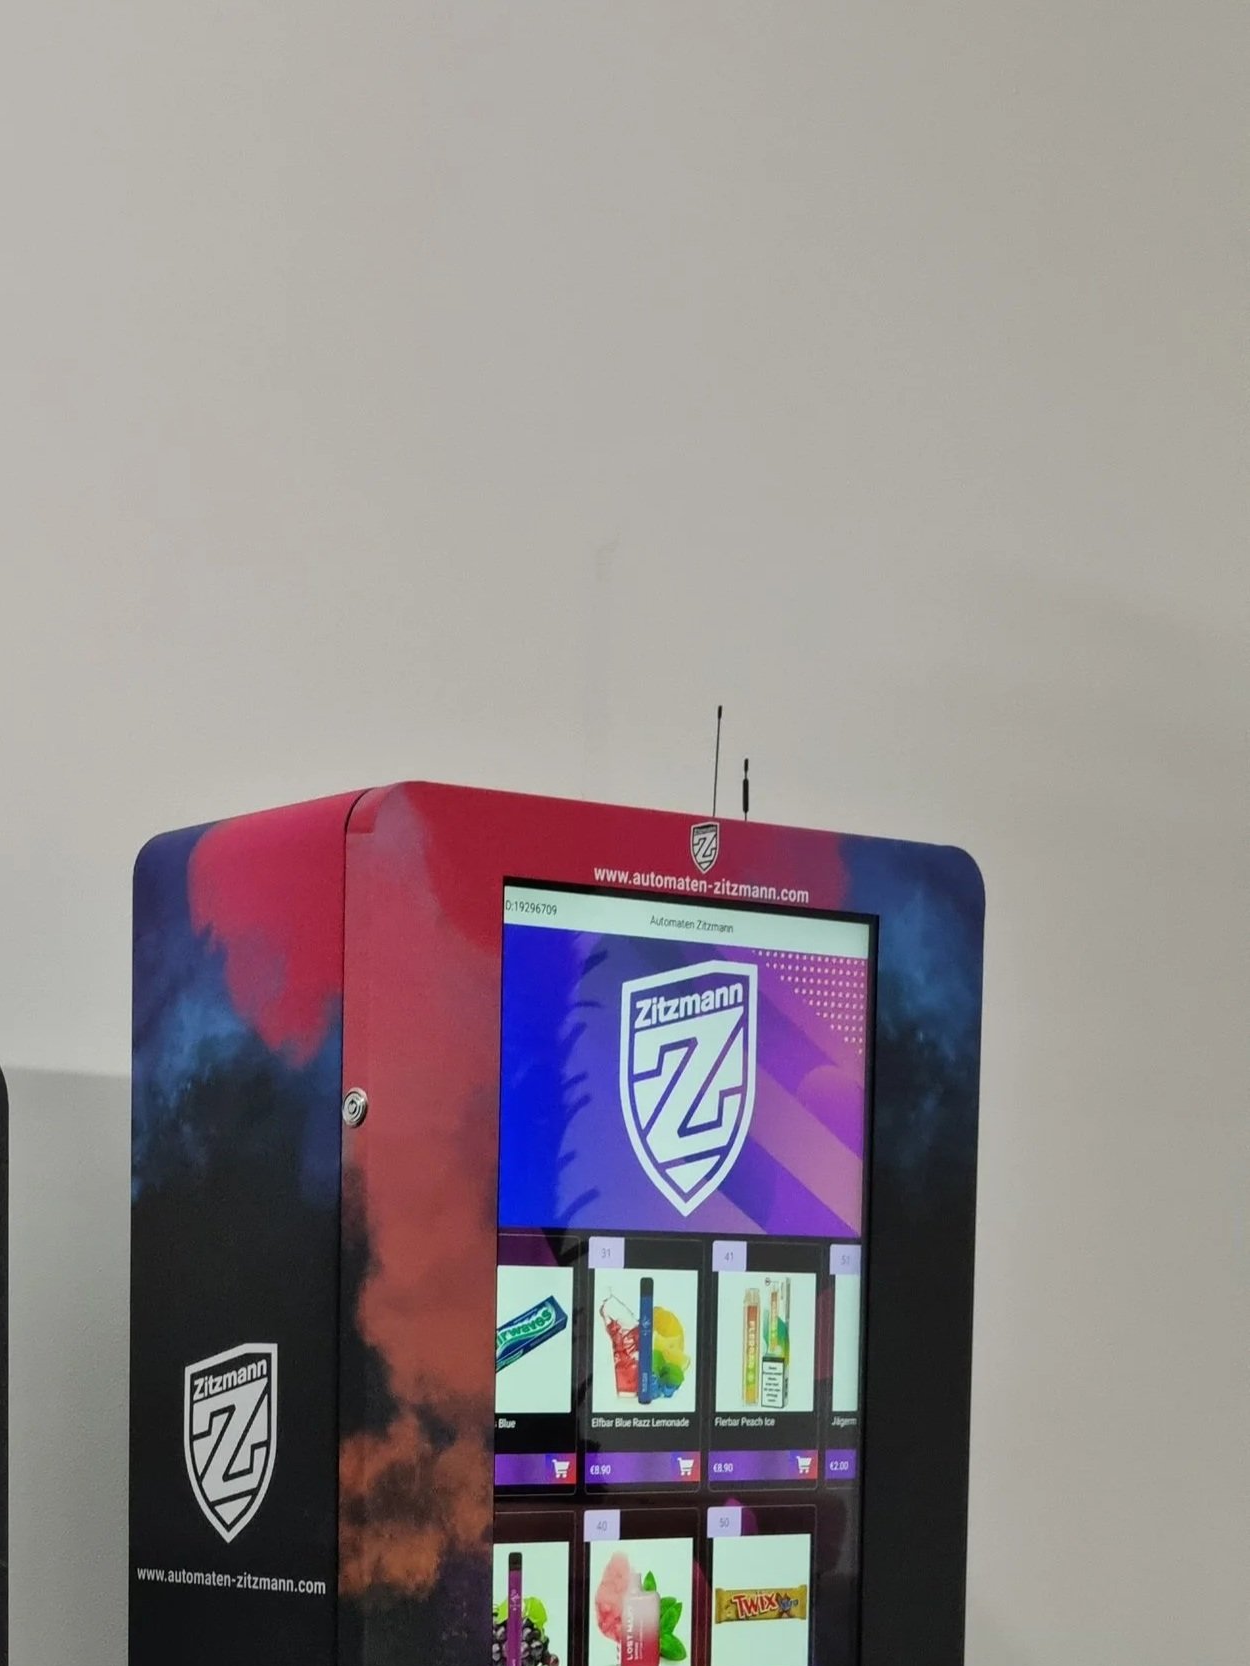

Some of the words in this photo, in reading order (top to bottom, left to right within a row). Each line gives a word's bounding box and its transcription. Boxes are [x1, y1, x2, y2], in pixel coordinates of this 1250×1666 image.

[593, 866, 809, 904] www.automaten-zitzmann.com
[505, 900, 558, 916] D:19296709
[650, 915, 695, 930] Automaten
[696, 919, 734, 934] Zitzmann
[634, 982, 744, 1029] Zitzmann
[724, 1251, 734, 1261] 41
[497, 1309, 552, 1346] irwaves
[192, 1358, 268, 1401] Zitzmann
[498, 1417, 516, 1429] Blue
[591, 1417, 614, 1428] Elfbar
[615, 1418, 632, 1428] Blue
[633, 1418, 650, 1428] Razz
[652, 1417, 690, 1428] Lemonade
[741, 1416, 763, 1427] Peach
[764, 1417, 775, 1427] Ice
[590, 1465, 611, 1476] €8.90
[829, 1461, 849, 1472] €2.00
[136, 1567, 327, 1595] www.automaten-zitzmann.com
